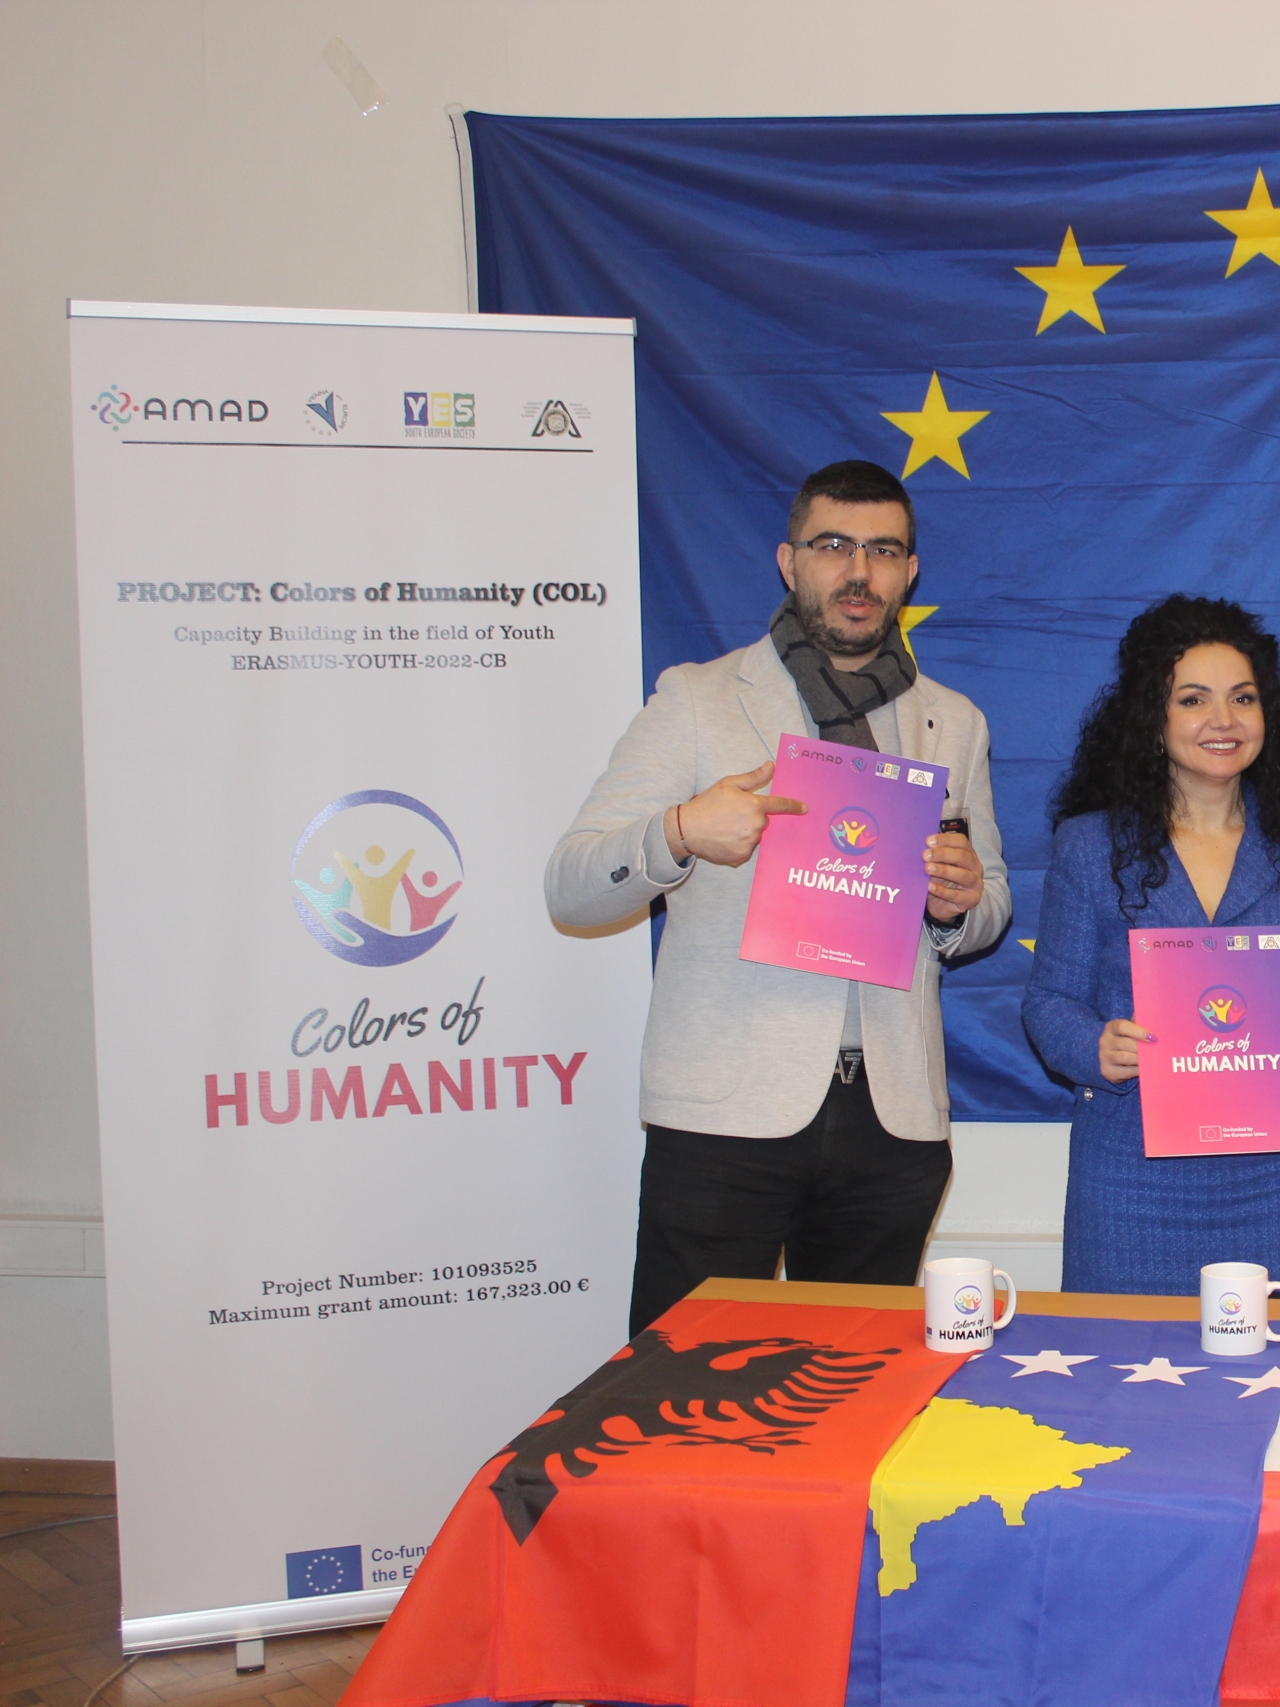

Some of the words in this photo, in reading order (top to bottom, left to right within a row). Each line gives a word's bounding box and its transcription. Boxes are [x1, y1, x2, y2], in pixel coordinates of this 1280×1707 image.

[144, 397, 269, 422] AMAD
[404, 394, 475, 424] YES
[405, 428, 422, 438] YOUTH
[424, 428, 451, 438] EUROPEAN
[453, 429, 475, 439] SOCIETY
[116, 582, 262, 603] PROJECT:
[269, 582, 357, 603] Colors
[364, 582, 391, 602] of
[397, 582, 525, 607] Humanity
[532, 582, 607, 606] (COL)
[174, 626, 263, 645] Capacity
[269, 626, 357, 644] Building
[363, 626, 383, 641] in
[389, 626, 420, 640] the
[426, 625, 469, 640] field
[475, 625, 495, 640] of
[500, 625, 555, 640] Youth
[231, 653, 507, 671] ERASMUS-YOUTH-2022-CB
[801, 750, 843, 765] AMAD
[816, 858, 857, 875] Colors
[859, 860, 876, 879] of
[787, 867, 901, 904] HUMANITY
[1153, 940, 1194, 949] AMAD
[291, 997, 428, 1058] Colors
[440, 976, 486, 1045] of
[1195, 1039, 1234, 1055] Colors
[1237, 1032, 1251, 1052] of
[1171, 1054, 1280, 1073] HUMANITY
[204, 1052, 588, 1129] HUMANITY
[261, 1276, 332, 1297] Project
[338, 1270, 423, 1289] Number:
[432, 1259, 538, 1281] 101093525
[208, 1306, 311, 1325] Maximum
[318, 1297, 372, 1319] grant
[379, 1289, 458, 1310] amount:
[466, 1280, 571, 1301] 167,323.00
[577, 1278, 590, 1292] €
[952, 1319, 977, 1330] Colors
[978, 1314, 985, 1327] of
[1208, 1325, 1257, 1334] HUMANITY
[1218, 1318, 1237, 1326] Colors
[1238, 1316, 1245, 1326] of
[939, 1325, 993, 1340] HUMANITY
[372, 1569, 397, 1582] the
